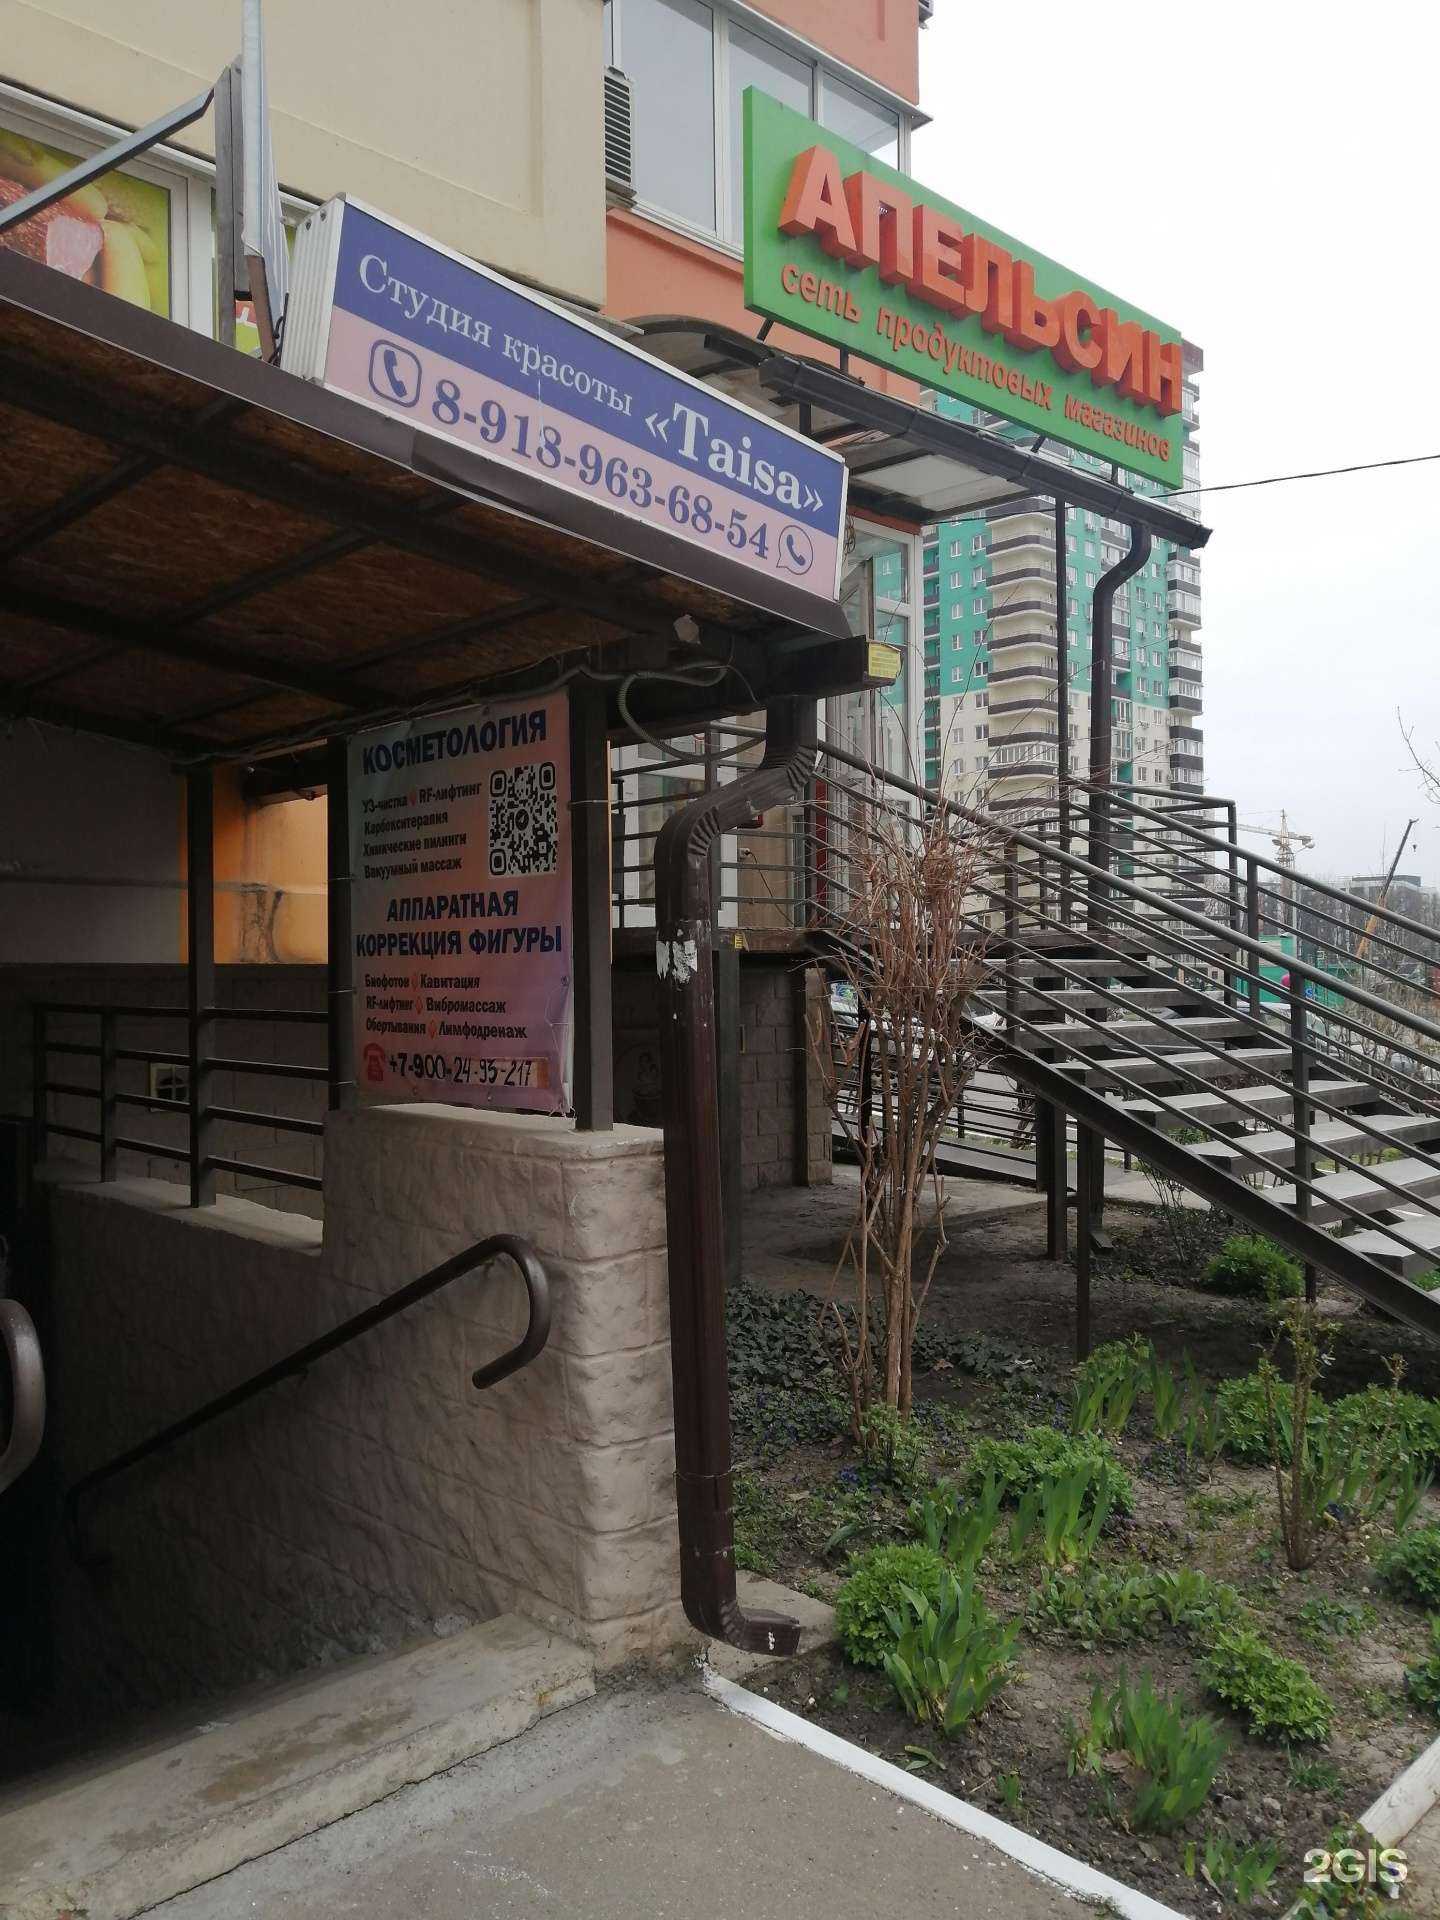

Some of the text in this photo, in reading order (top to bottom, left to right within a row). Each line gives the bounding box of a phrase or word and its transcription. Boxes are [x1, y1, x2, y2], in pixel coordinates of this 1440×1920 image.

[778, 144, 1183, 417] АПЕЛЬСИН
[781, 264, 1170, 462] сеть продуктовых магазинов
[358, 254, 824, 514] Студия красоты «Taisa»
[432, 378, 769, 560] 8-918-963-68-54
[362, 709, 546, 775] КОСМЕТОЛОГИЯ
[418, 780, 482, 803] RF-лифтинг
[364, 812, 448, 836] Карбокситерапия
[363, 833, 466, 857] Химические пилинги
[364, 858, 463, 880] Вакуумный массаж
[386, 889, 519, 922] АППАРАТНАЯ
[356, 925, 562, 960] КОРРЕКЦИЯ ФИГУРЫ
[420, 974, 480, 991] Кавитация
[426, 997, 506, 1015] Вибромассаж
[366, 1017, 528, 1040] Обертывания Лимфодренаж
